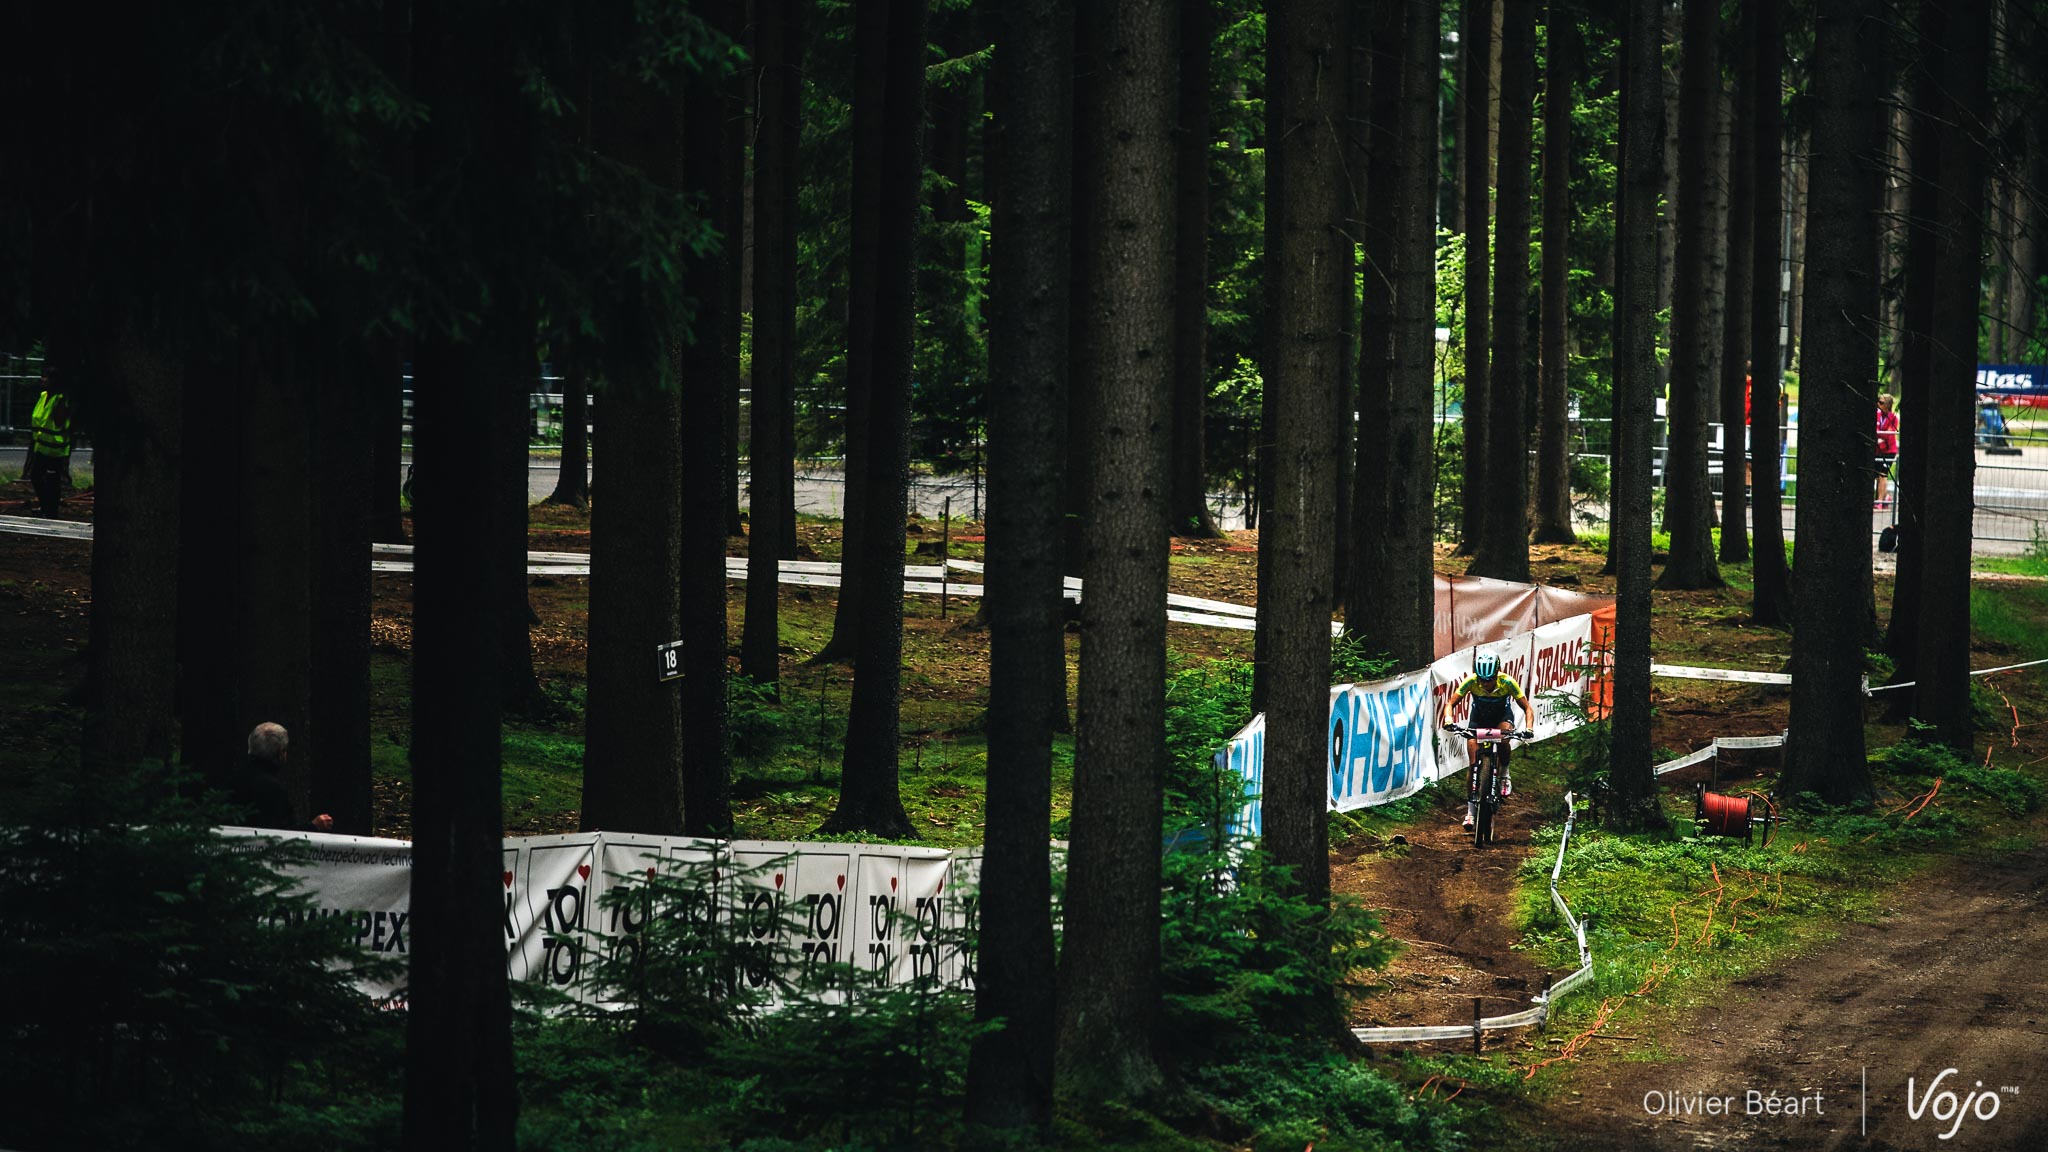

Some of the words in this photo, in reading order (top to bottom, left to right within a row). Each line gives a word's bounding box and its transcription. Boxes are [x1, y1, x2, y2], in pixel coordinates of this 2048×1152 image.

[664, 649, 677, 669] 18
[1534, 636, 1586, 695] STRABAG
[545, 885, 586, 934] TOI
[743, 892, 780, 938] TOI
[807, 893, 843, 940] TOI
[870, 895, 895, 941] TOI
[914, 896, 941, 941] TOI
[542, 936, 583, 985] TOI
[802, 942, 838, 989] TOI
[869, 943, 890, 989] TOI
[909, 943, 939, 988] TOI
